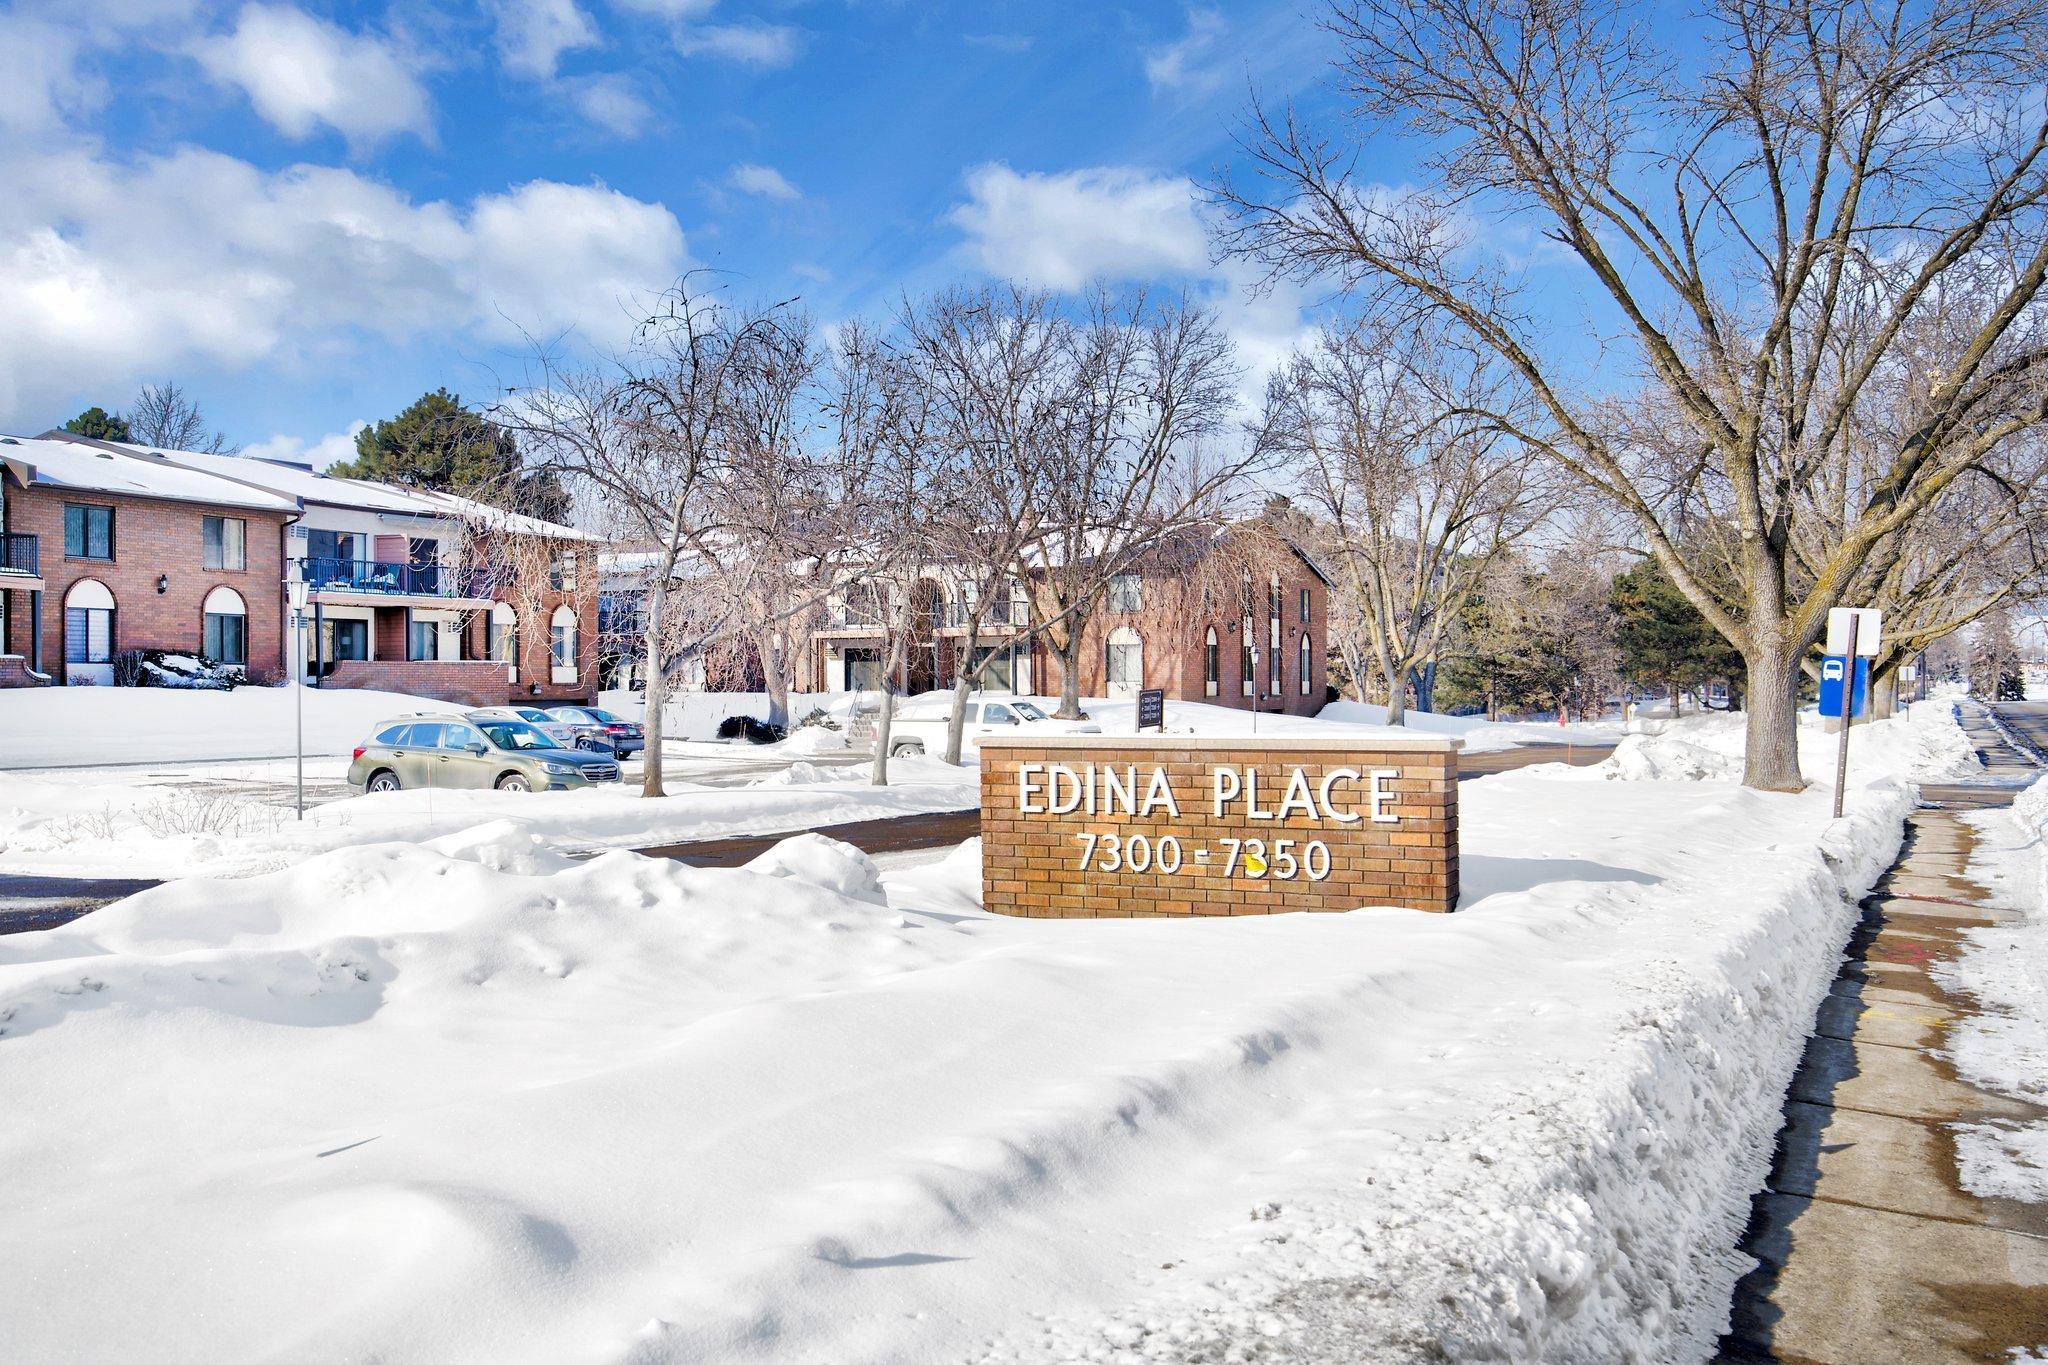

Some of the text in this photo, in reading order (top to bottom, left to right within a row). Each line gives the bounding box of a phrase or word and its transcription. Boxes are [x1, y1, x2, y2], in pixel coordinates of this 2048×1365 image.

[1019, 764, 1400, 823] EDINA PLACE
[1076, 832, 1183, 875] 7300
[1219, 838, 1332, 881] 7350
